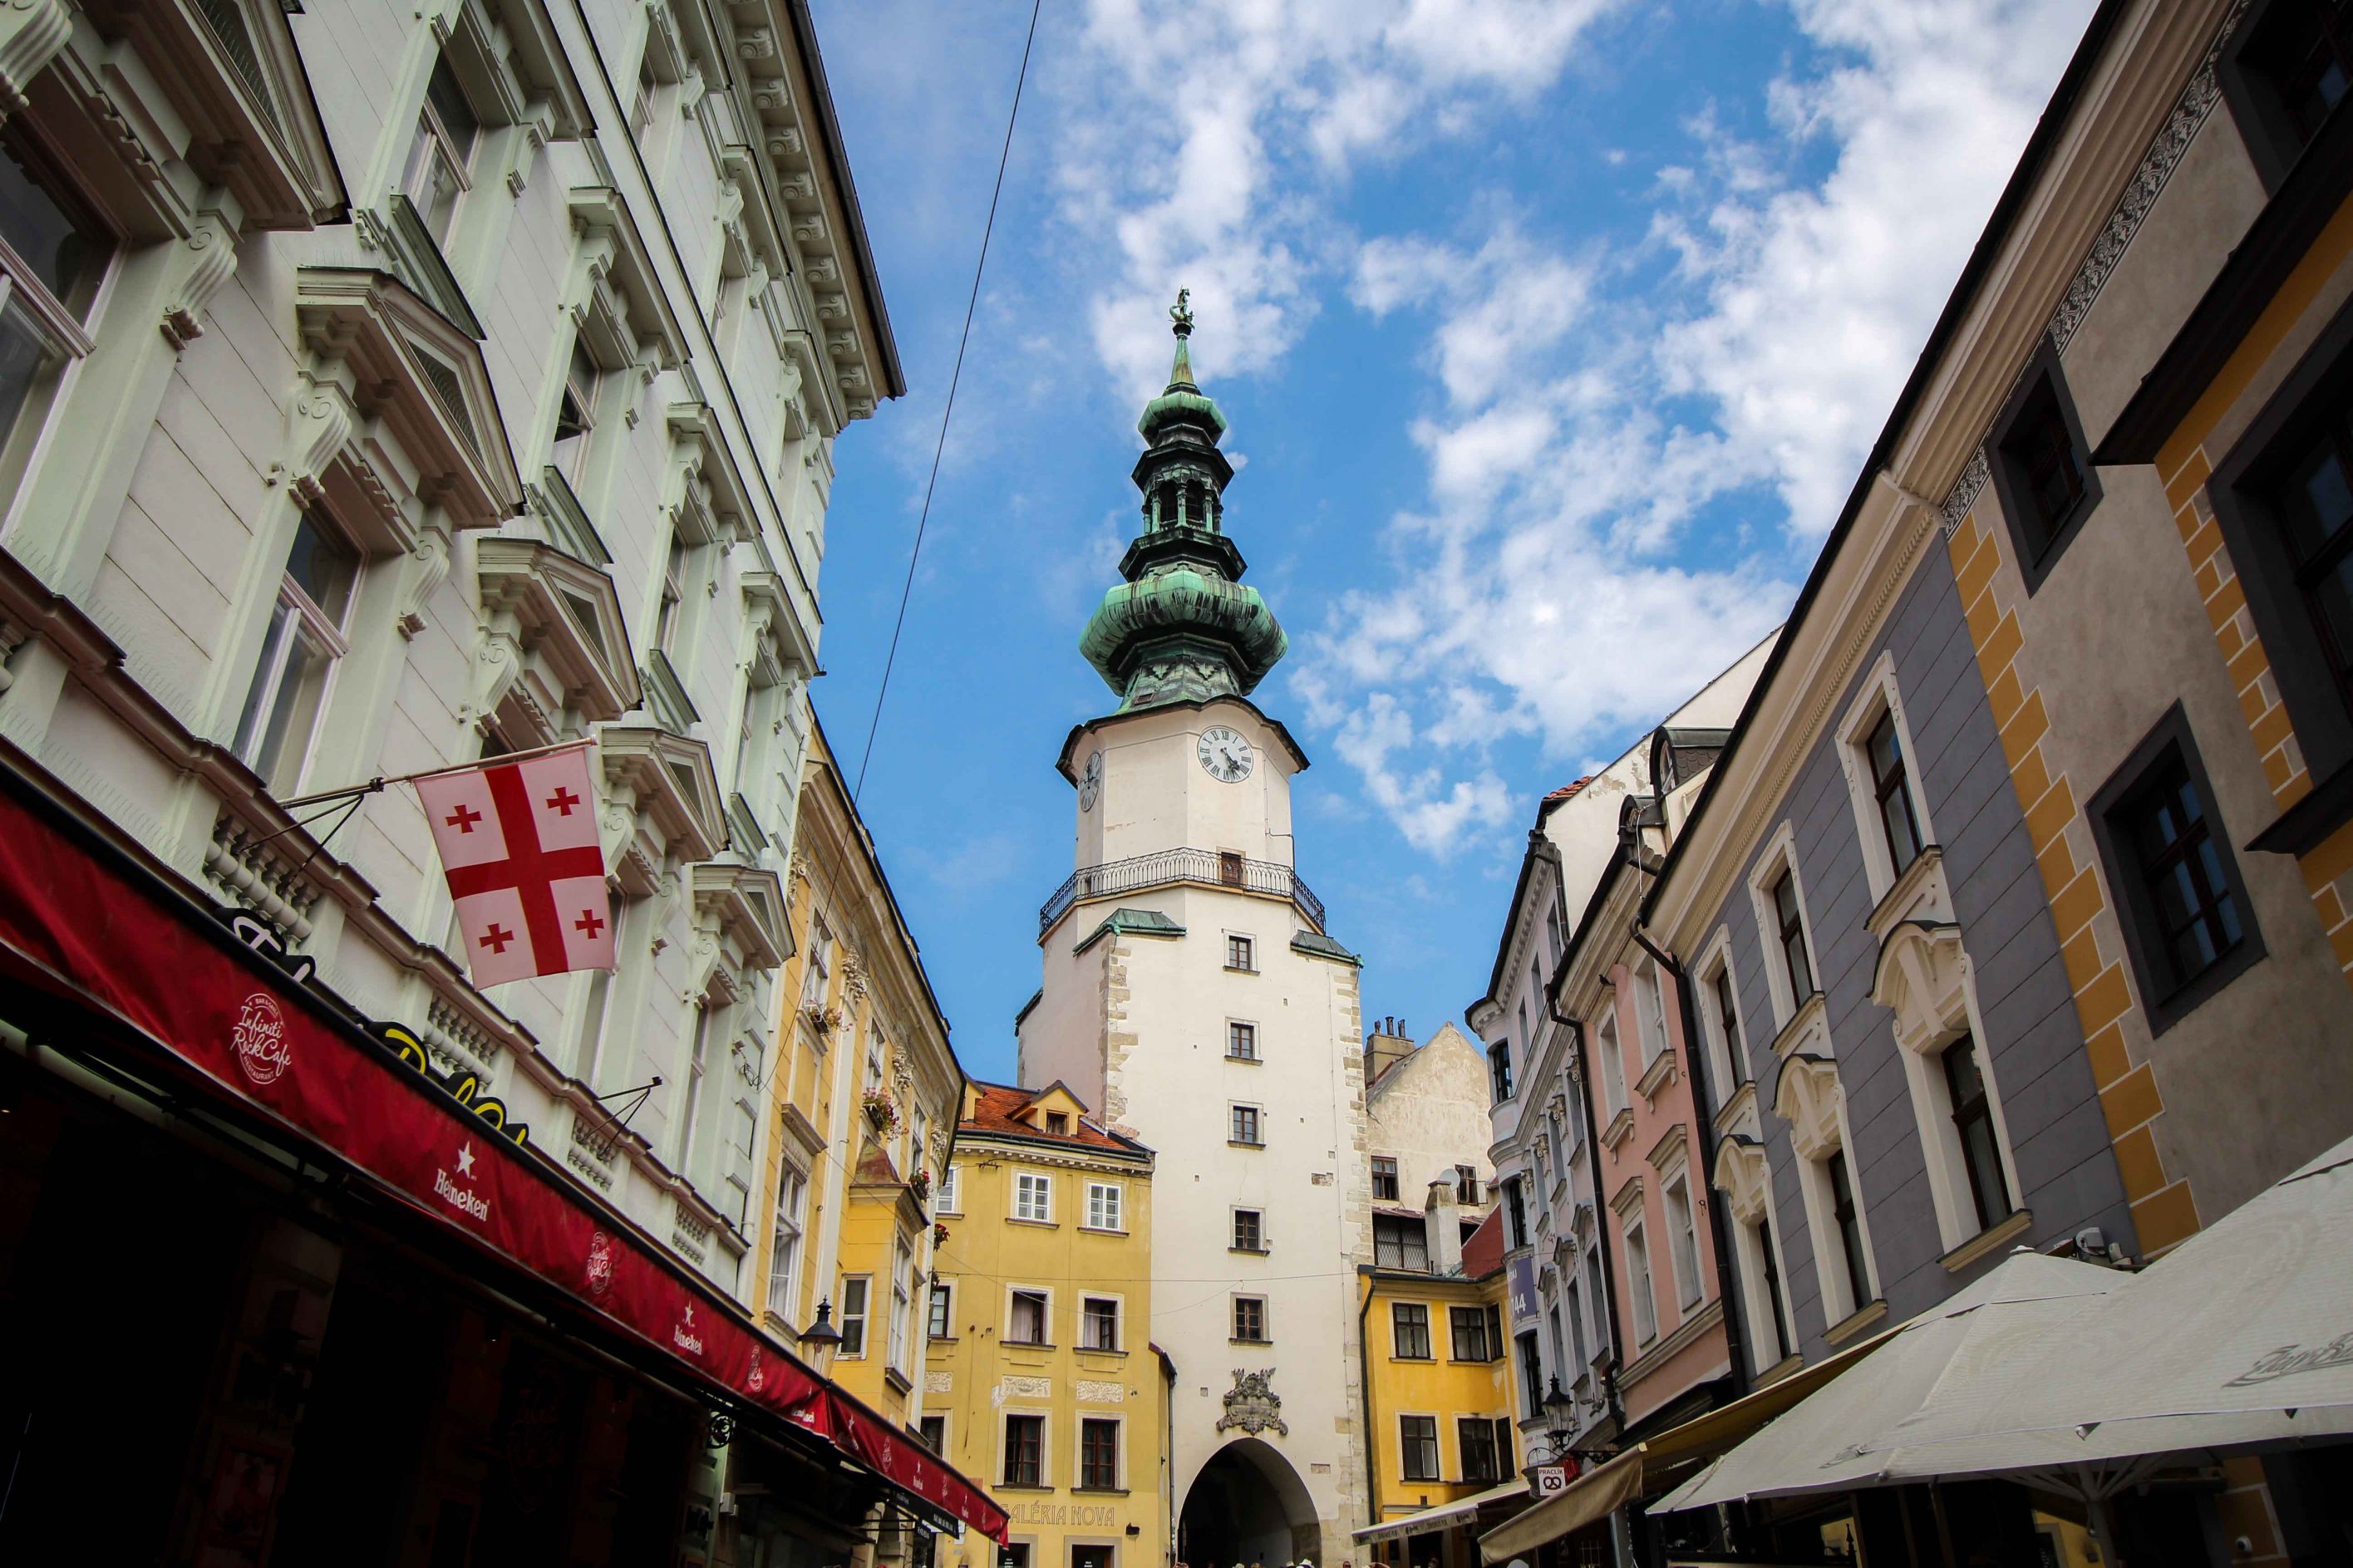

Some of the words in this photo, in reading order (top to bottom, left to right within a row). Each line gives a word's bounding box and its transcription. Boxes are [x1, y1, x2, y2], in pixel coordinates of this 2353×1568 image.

[238, 1005, 283, 1043] Infiniti
[433, 1167, 488, 1222] Heineken
[1071, 1505, 1115, 1526] NOVA
